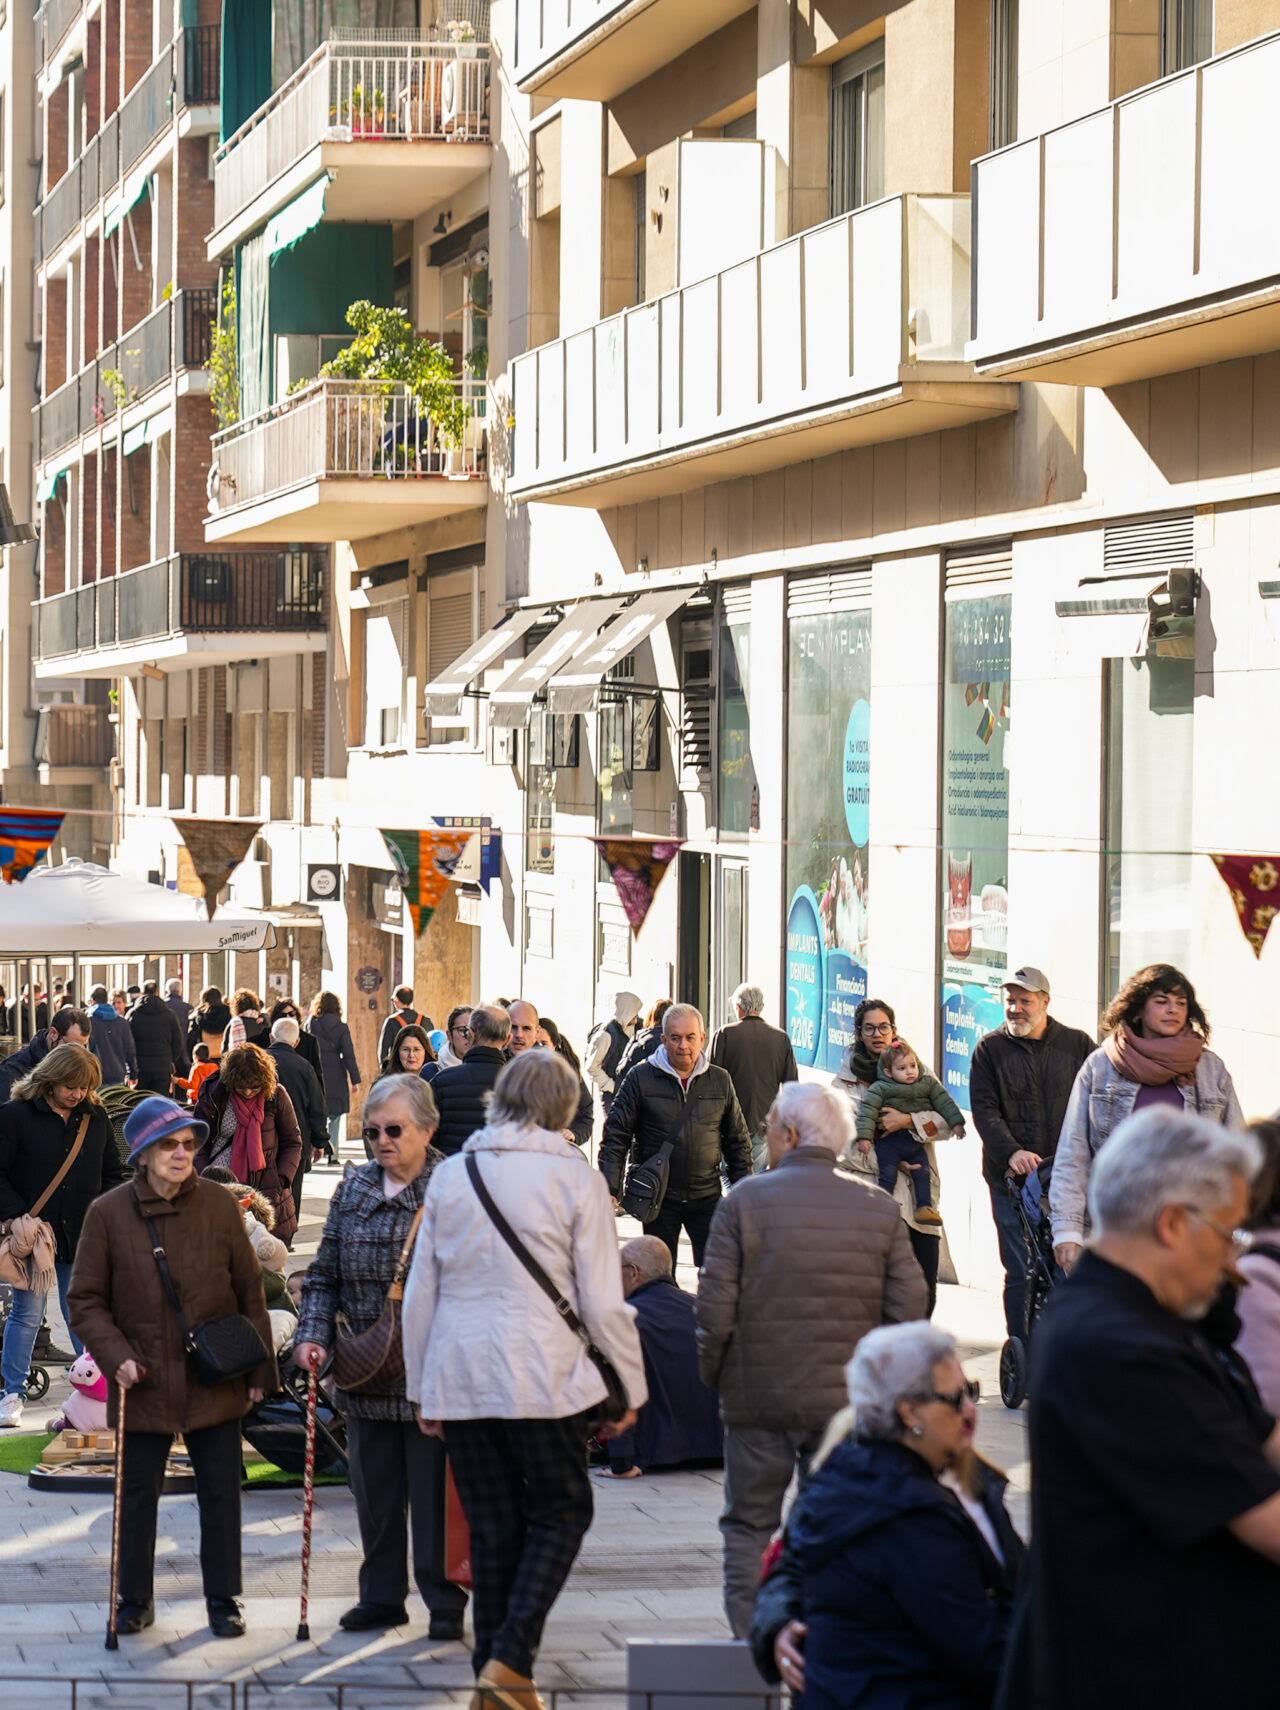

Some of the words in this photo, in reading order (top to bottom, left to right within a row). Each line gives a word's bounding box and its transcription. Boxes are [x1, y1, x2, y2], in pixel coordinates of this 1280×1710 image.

[855, 740, 869, 753] VISITA
[996, 768, 1005, 781] oral
[787, 932, 818, 956] IMPLANTS
[790, 961, 815, 985] DENTALS
[835, 973, 865, 997] Financiació
[946, 1006, 976, 1030] Implants
[791, 1016, 814, 1050] 220€
[946, 1032, 969, 1057] dentals
